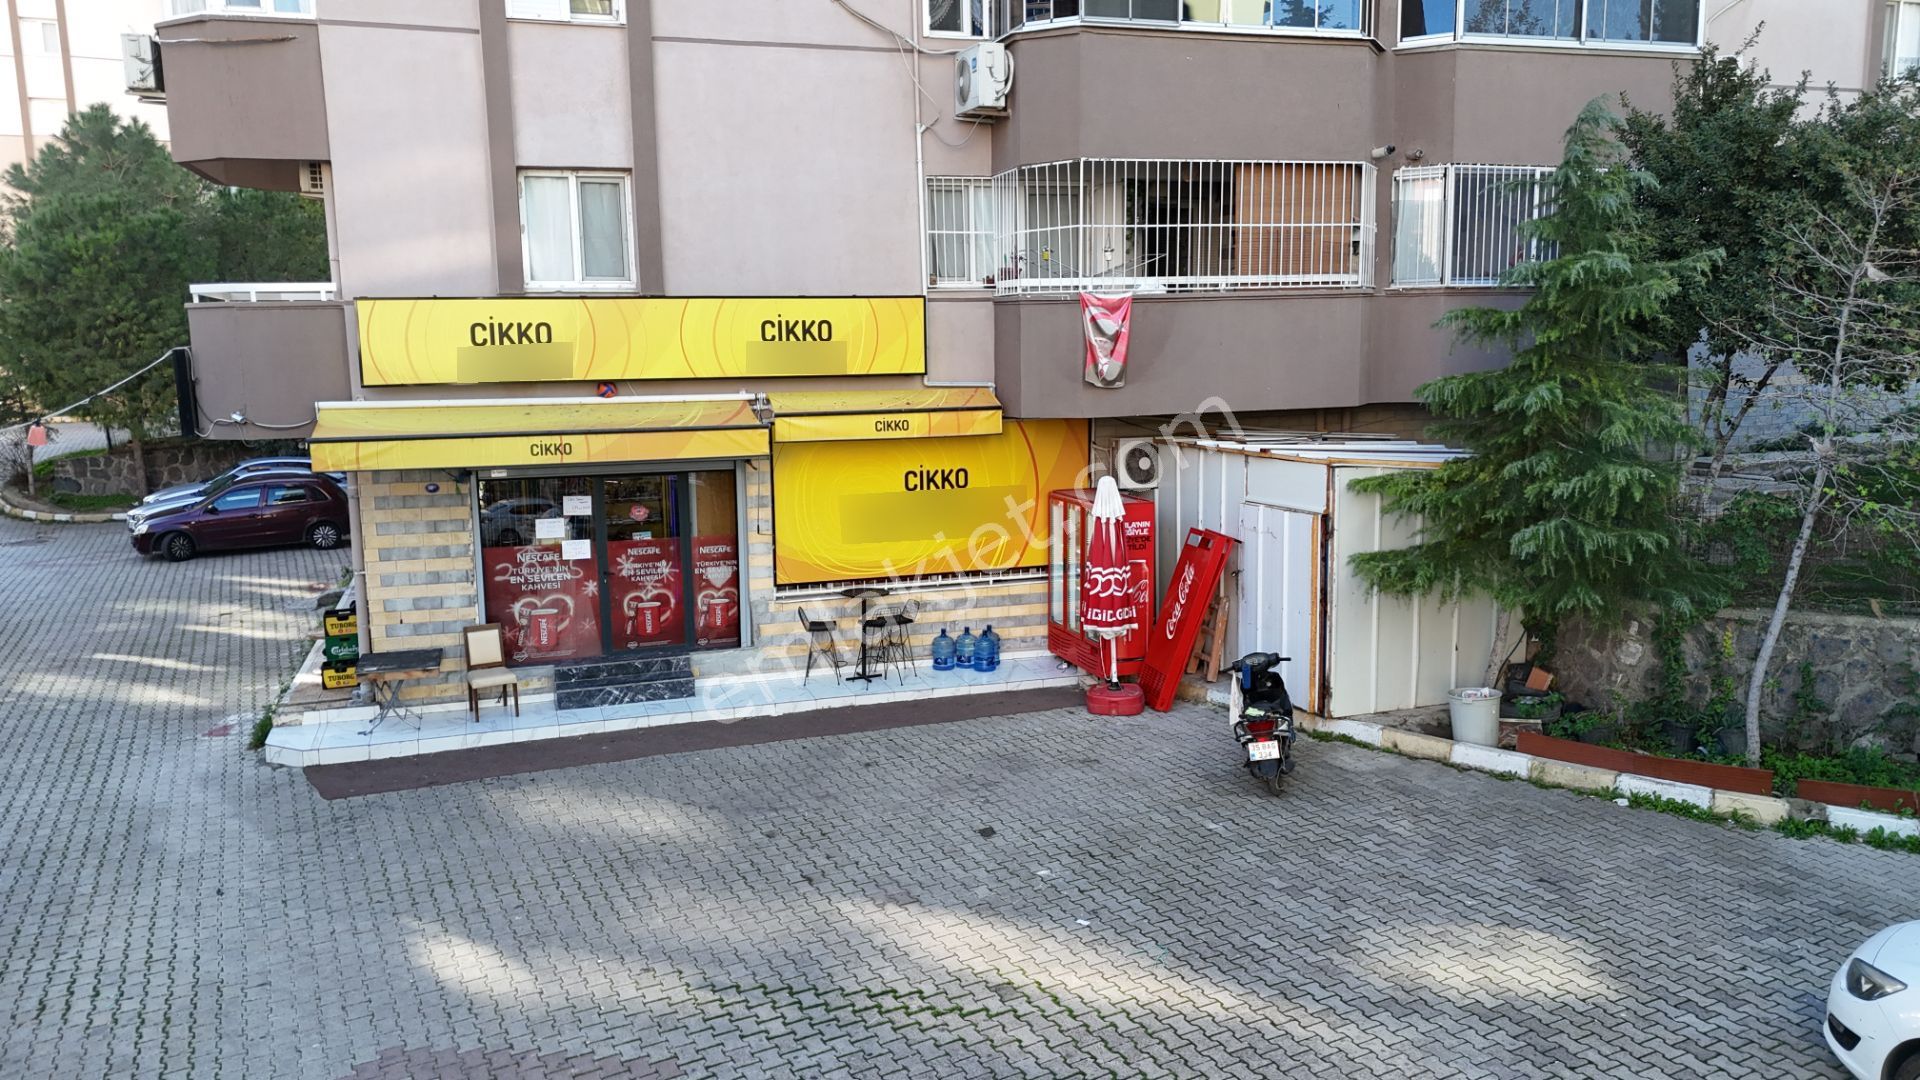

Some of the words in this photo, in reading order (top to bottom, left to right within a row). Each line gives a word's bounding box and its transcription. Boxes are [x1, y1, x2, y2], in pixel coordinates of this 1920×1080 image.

[470, 316, 553, 347] CİKKO
[760, 314, 833, 342] CİKKO
[875, 417, 910, 432] CİKKO
[530, 442, 573, 457] CİKKO
[904, 464, 969, 492] CİKKO
[510, 575, 525, 584] EN
[521, 581, 561, 591] KAHVESİ
